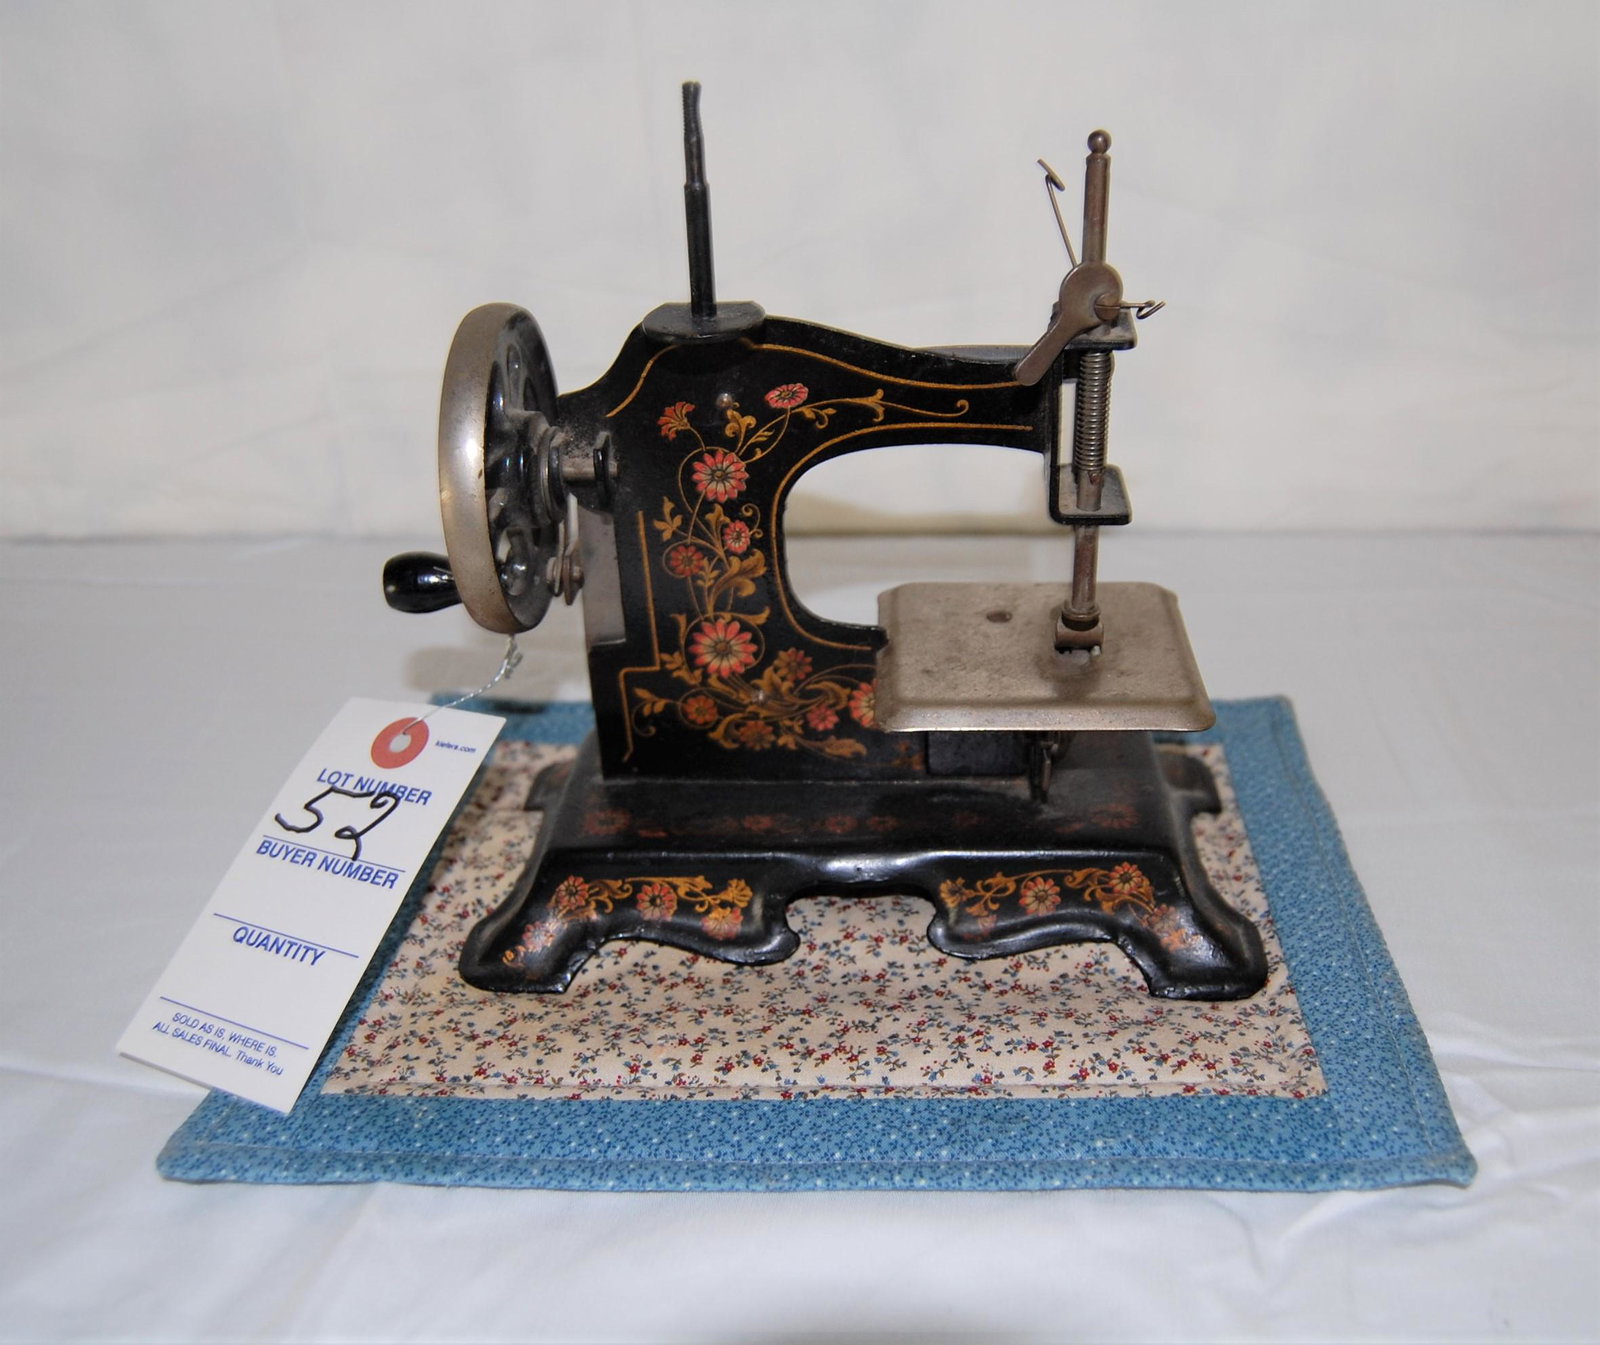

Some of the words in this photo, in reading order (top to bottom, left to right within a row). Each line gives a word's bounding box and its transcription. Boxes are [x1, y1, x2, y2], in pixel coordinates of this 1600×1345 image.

[317, 768, 353, 786] LOT
[354, 776, 432, 806] NUMBER
[275, 786, 401, 861] 52
[256, 840, 318, 868] BUYER
[317, 855, 400, 889] NUMBER
[232, 926, 326, 966] QUANTITY
[152, 1021, 170, 1035] ALL
[171, 1027, 204, 1046] SALES
[236, 1050, 265, 1069] Thank
[266, 1061, 284, 1076] You
[172, 1012, 200, 1029] SOLD
[199, 1022, 215, 1034] AS
[228, 1032, 266, 1053] WHERE
